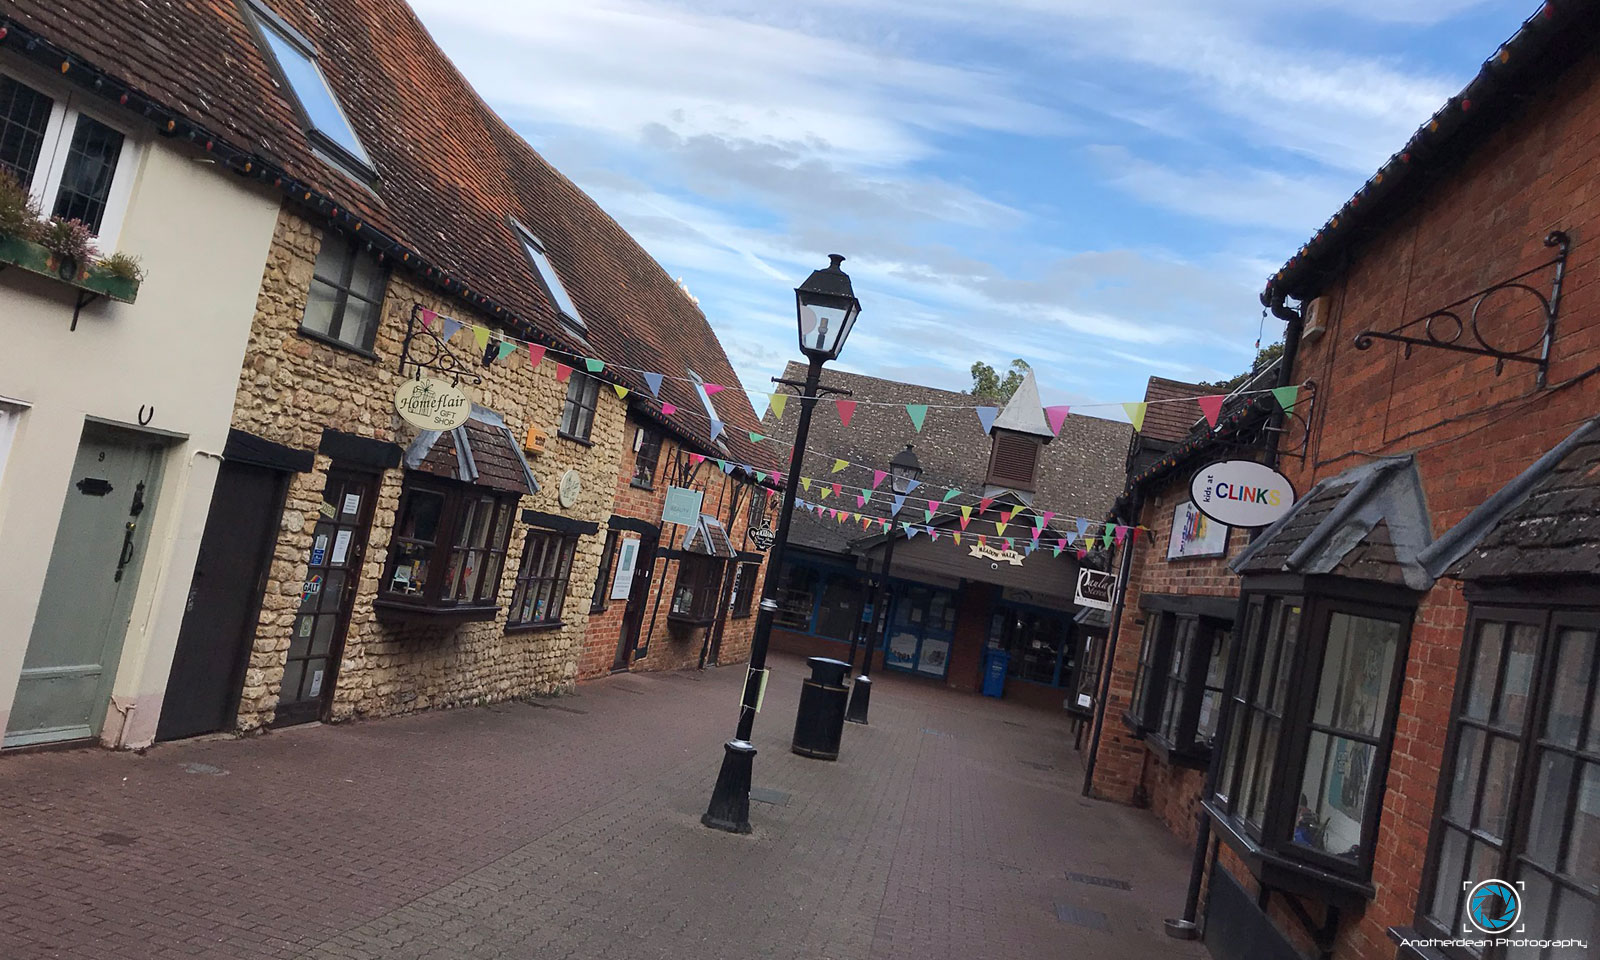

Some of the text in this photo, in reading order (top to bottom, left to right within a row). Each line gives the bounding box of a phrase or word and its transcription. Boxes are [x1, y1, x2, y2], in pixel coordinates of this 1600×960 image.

[399, 393, 466, 413] Homeflair
[440, 410, 456, 419] GIFT
[433, 416, 455, 427] SHOP
[98, 451, 106, 462] 9
[1203, 475, 1214, 502] kids at
[1215, 482, 1281, 506] CLINKS
[302, 582, 320, 593] GALT
